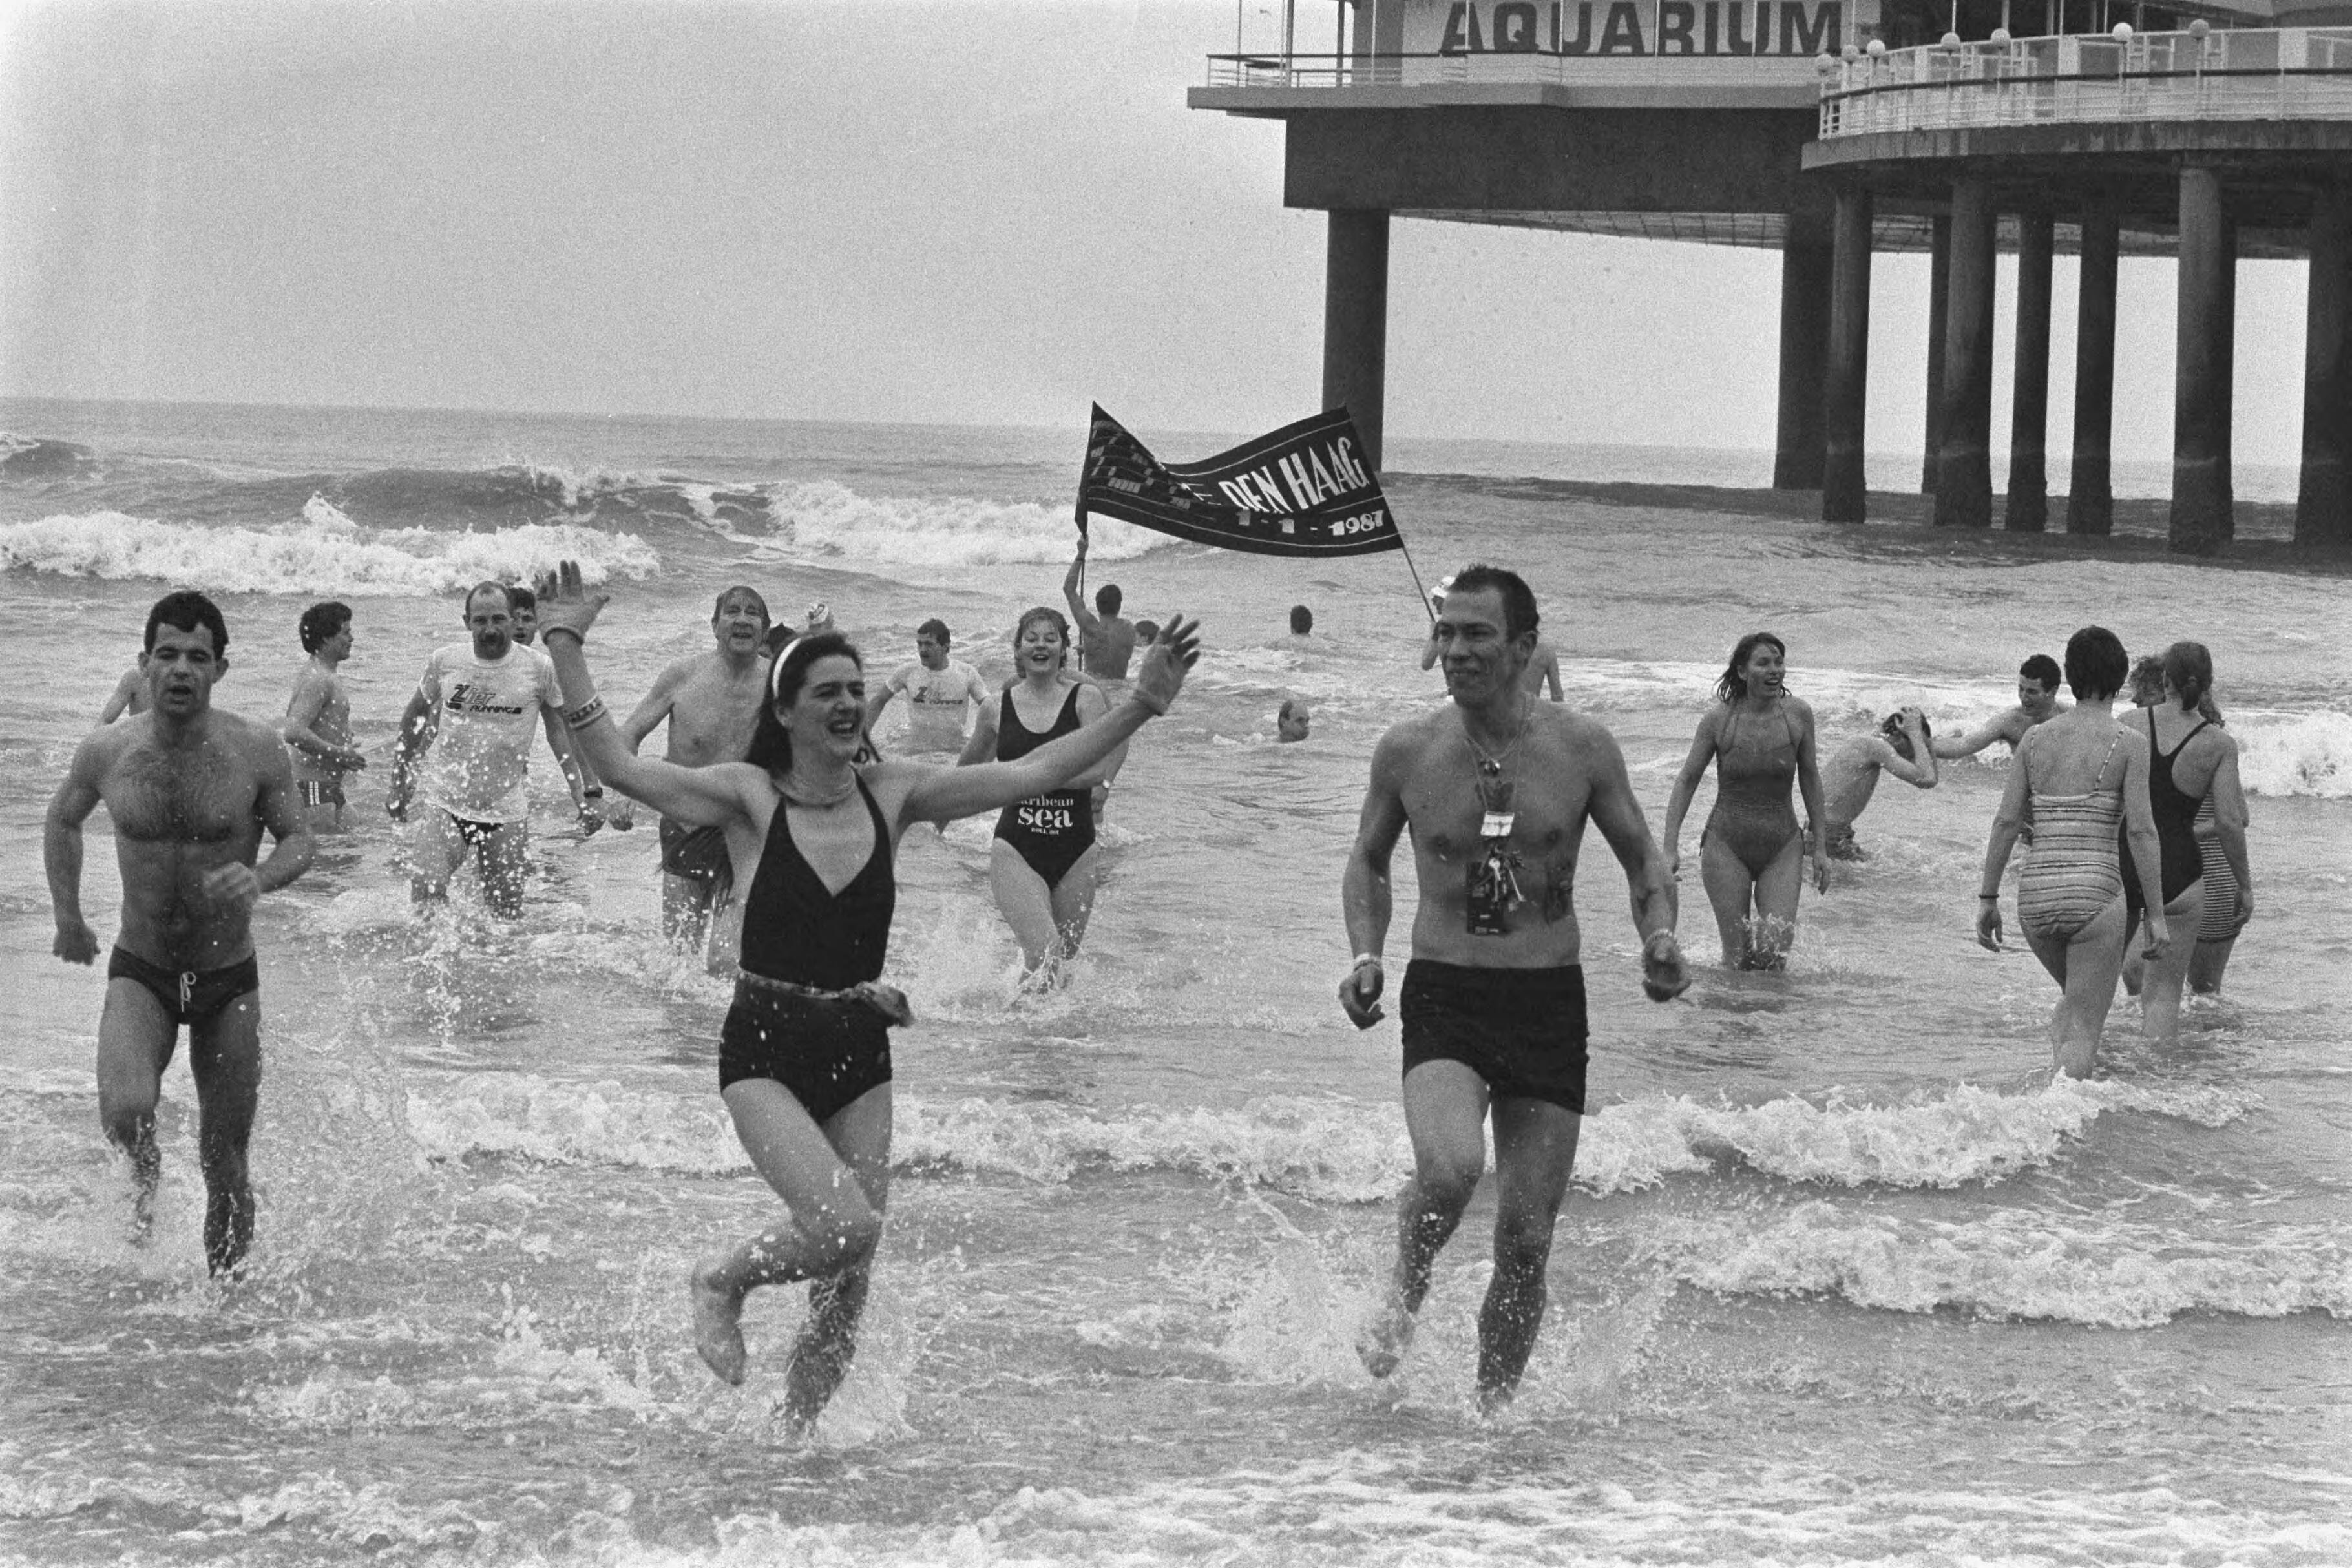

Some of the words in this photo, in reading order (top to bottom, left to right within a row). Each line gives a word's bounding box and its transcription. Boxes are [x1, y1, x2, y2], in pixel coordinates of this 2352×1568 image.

[1441, 1, 1842, 54] AQUARIUM
[1218, 466, 1293, 514] DEN
[1278, 437, 1369, 510] HAAG
[1328, 509, 1384, 536] 1987
[1018, 807, 1073, 828] sea
